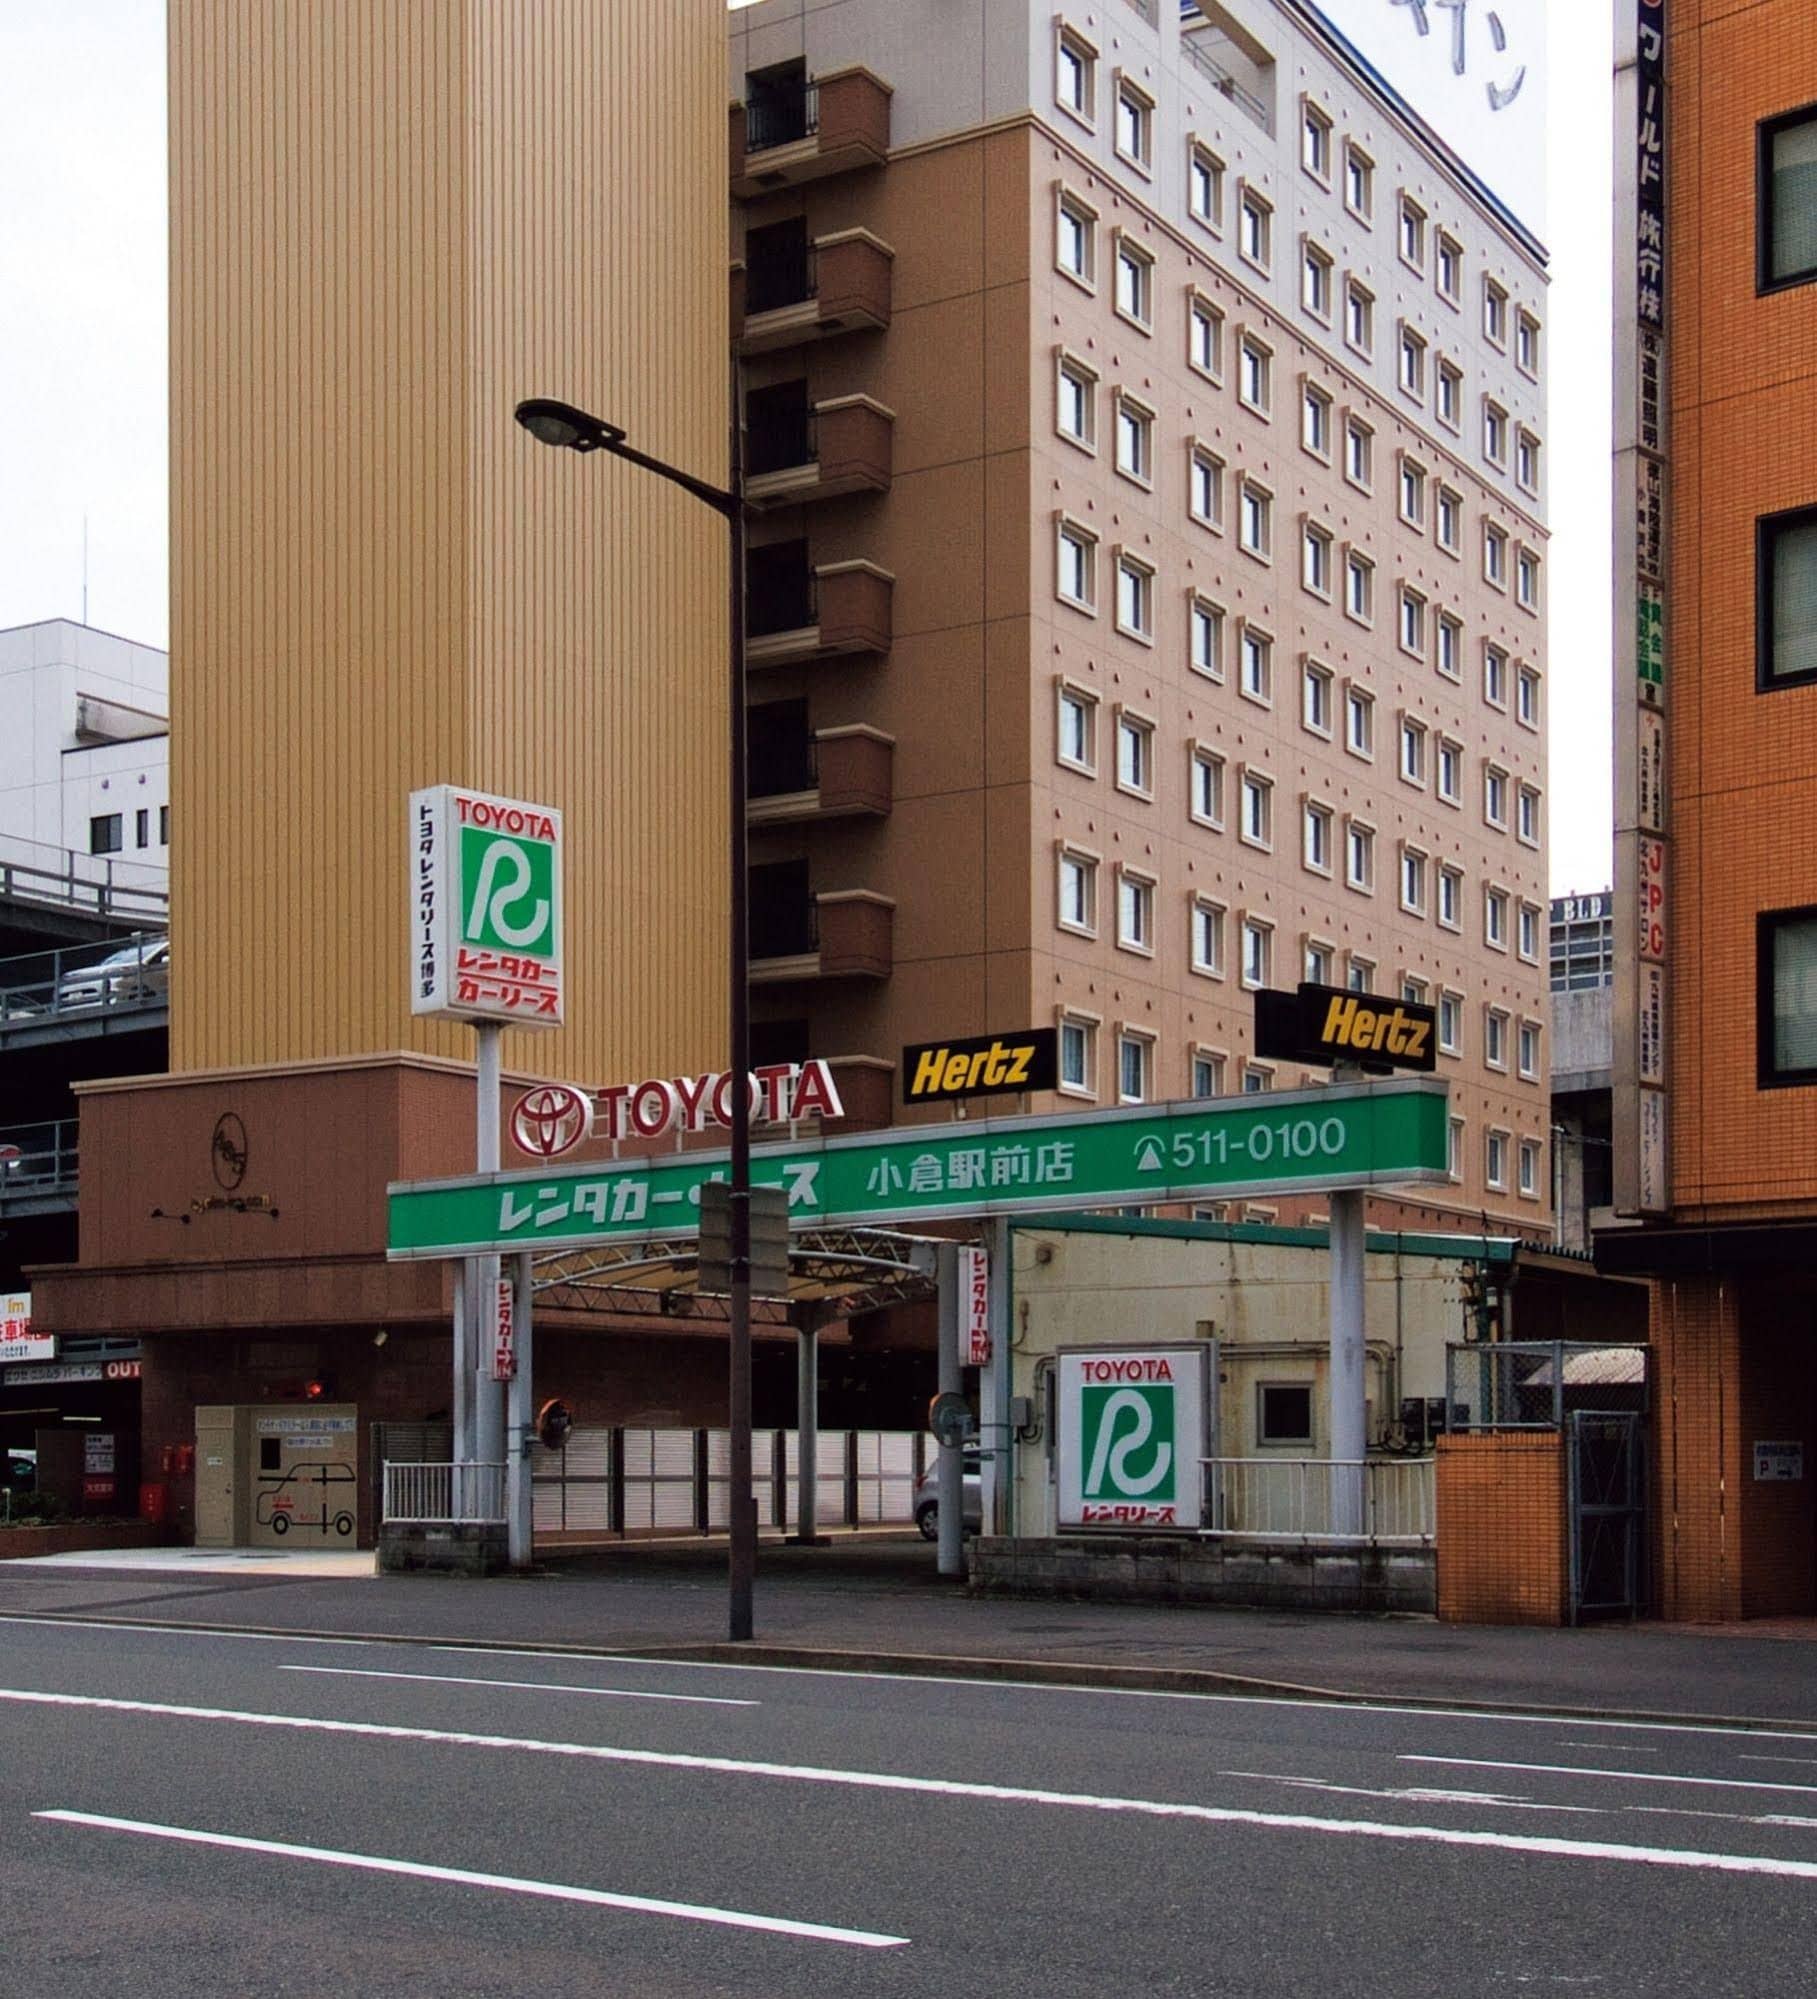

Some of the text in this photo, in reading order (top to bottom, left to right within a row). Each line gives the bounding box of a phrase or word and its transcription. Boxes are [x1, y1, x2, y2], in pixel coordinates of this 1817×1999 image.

[455, 797, 556, 842] TOYOTA
[419, 804, 436, 999] トヨタレンタリース博多
[1563, 896, 1602, 921] BLD
[456, 948, 558, 984] レンタカー
[457, 979, 560, 1016] カーリース
[1320, 995, 1431, 1058] Hertz
[910, 1040, 1036, 1096] Hertz
[597, 1059, 844, 1140] TOYOTA
[866, 1141, 1076, 1197] 小倉駅前店
[1172, 1117, 1346, 1168] 511-0100
[499, 1161, 820, 1232] レンタカー・ース
[498, 1282, 511, 1348] レンタカー
[973, 1252, 986, 1328] レンタカー
[107, 1361, 142, 1378] OUT
[1081, 1358, 1173, 1383] TOYOTA
[1081, 1504, 1176, 1525] レンタリース
